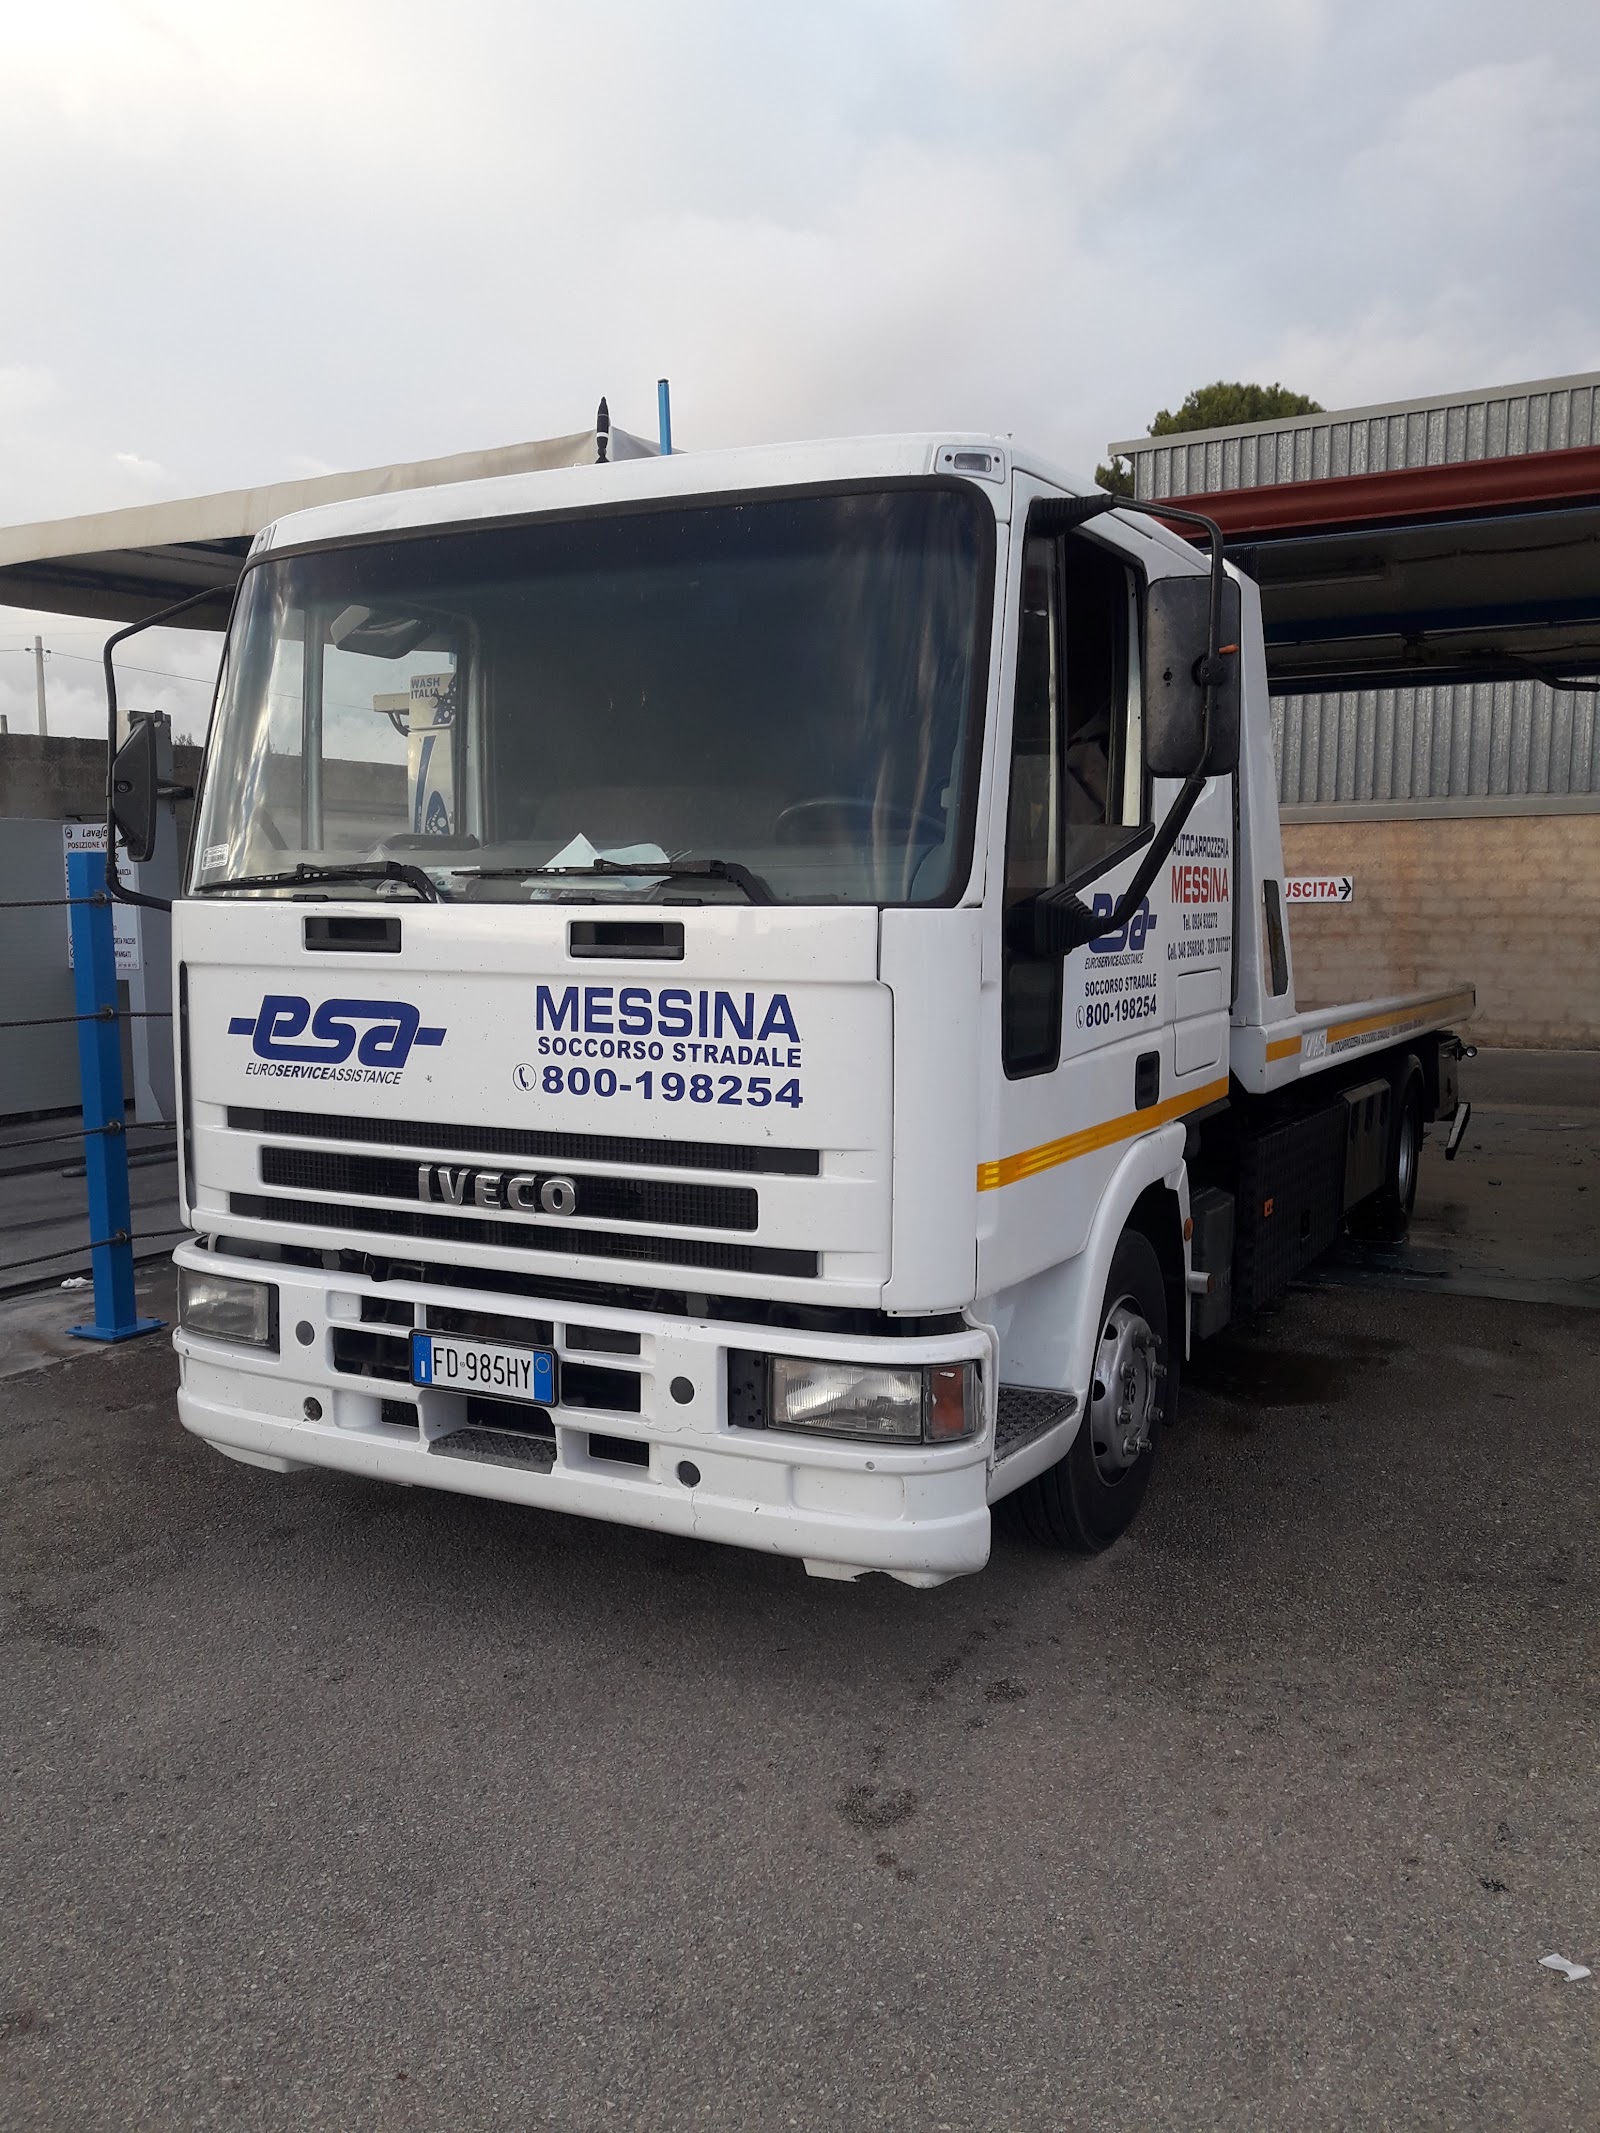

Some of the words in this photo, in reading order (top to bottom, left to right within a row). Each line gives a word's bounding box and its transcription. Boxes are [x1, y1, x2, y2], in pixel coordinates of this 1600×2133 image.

[411, 677, 441, 689] WASH
[411, 688, 439, 700] ITALIA
[67, 841, 100, 849] POSIZIONE
[1172, 833, 1230, 859] AUTOCARROZZERIA
[1171, 865, 1229, 904] MESSINA
[1084, 952, 1144, 970] EUROSERVICEASSISTANCE
[1085, 977, 1123, 998] SOCCORSO
[1124, 972, 1157, 992] STRADALE
[535, 985, 801, 1043] MESSINA
[1086, 993, 1157, 1028] 800-198254
[537, 1036, 664, 1061] SOCCORSO
[672, 1042, 802, 1068] STRADALE
[245, 1062, 404, 1085] EUROSERVICEASSISTANCE
[541, 1065, 804, 1108] 800-198254
[417, 1164, 577, 1216] IVECO
